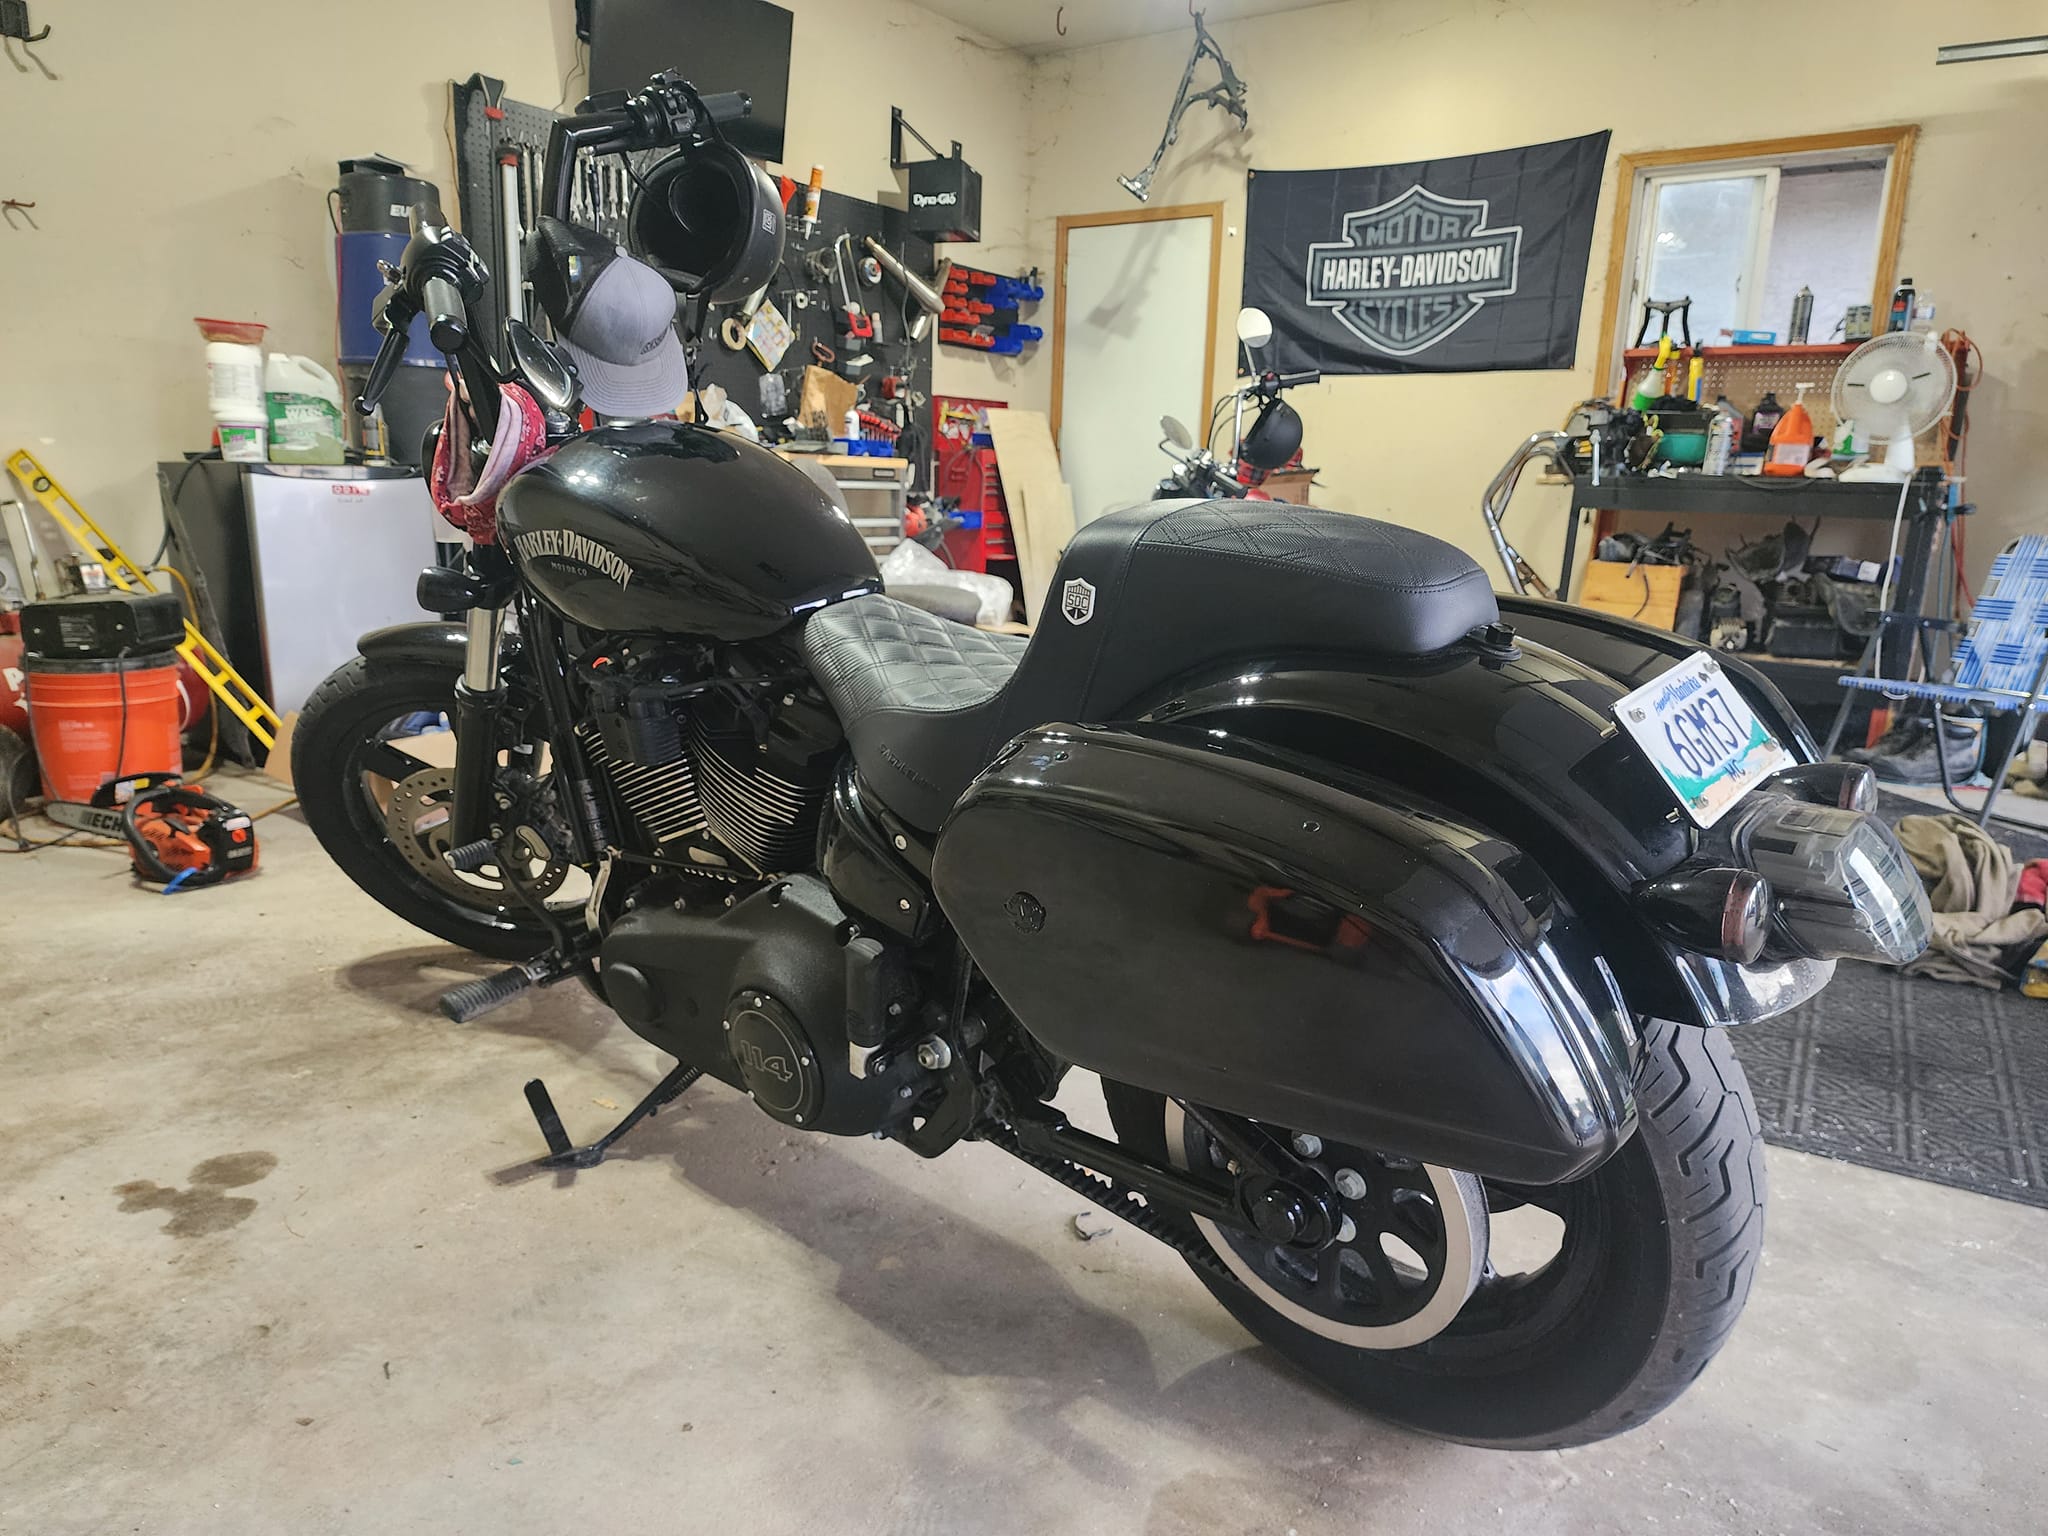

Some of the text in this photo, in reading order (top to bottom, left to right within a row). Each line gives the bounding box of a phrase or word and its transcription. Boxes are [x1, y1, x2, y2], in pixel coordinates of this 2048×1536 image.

[1365, 206, 1460, 247] MOTOR
[1322, 246, 1502, 290] HARLEY-DAVIDSON
[1358, 295, 1452, 342] CYCLES
[551, 561, 588, 577] MOTOR CO
[1067, 593, 1089, 609] SDC
[1663, 688, 1750, 777] 6GM37
[1723, 759, 1746, 782] MC
[90, 812, 125, 832] ECH
[740, 1039, 794, 1083] 114
